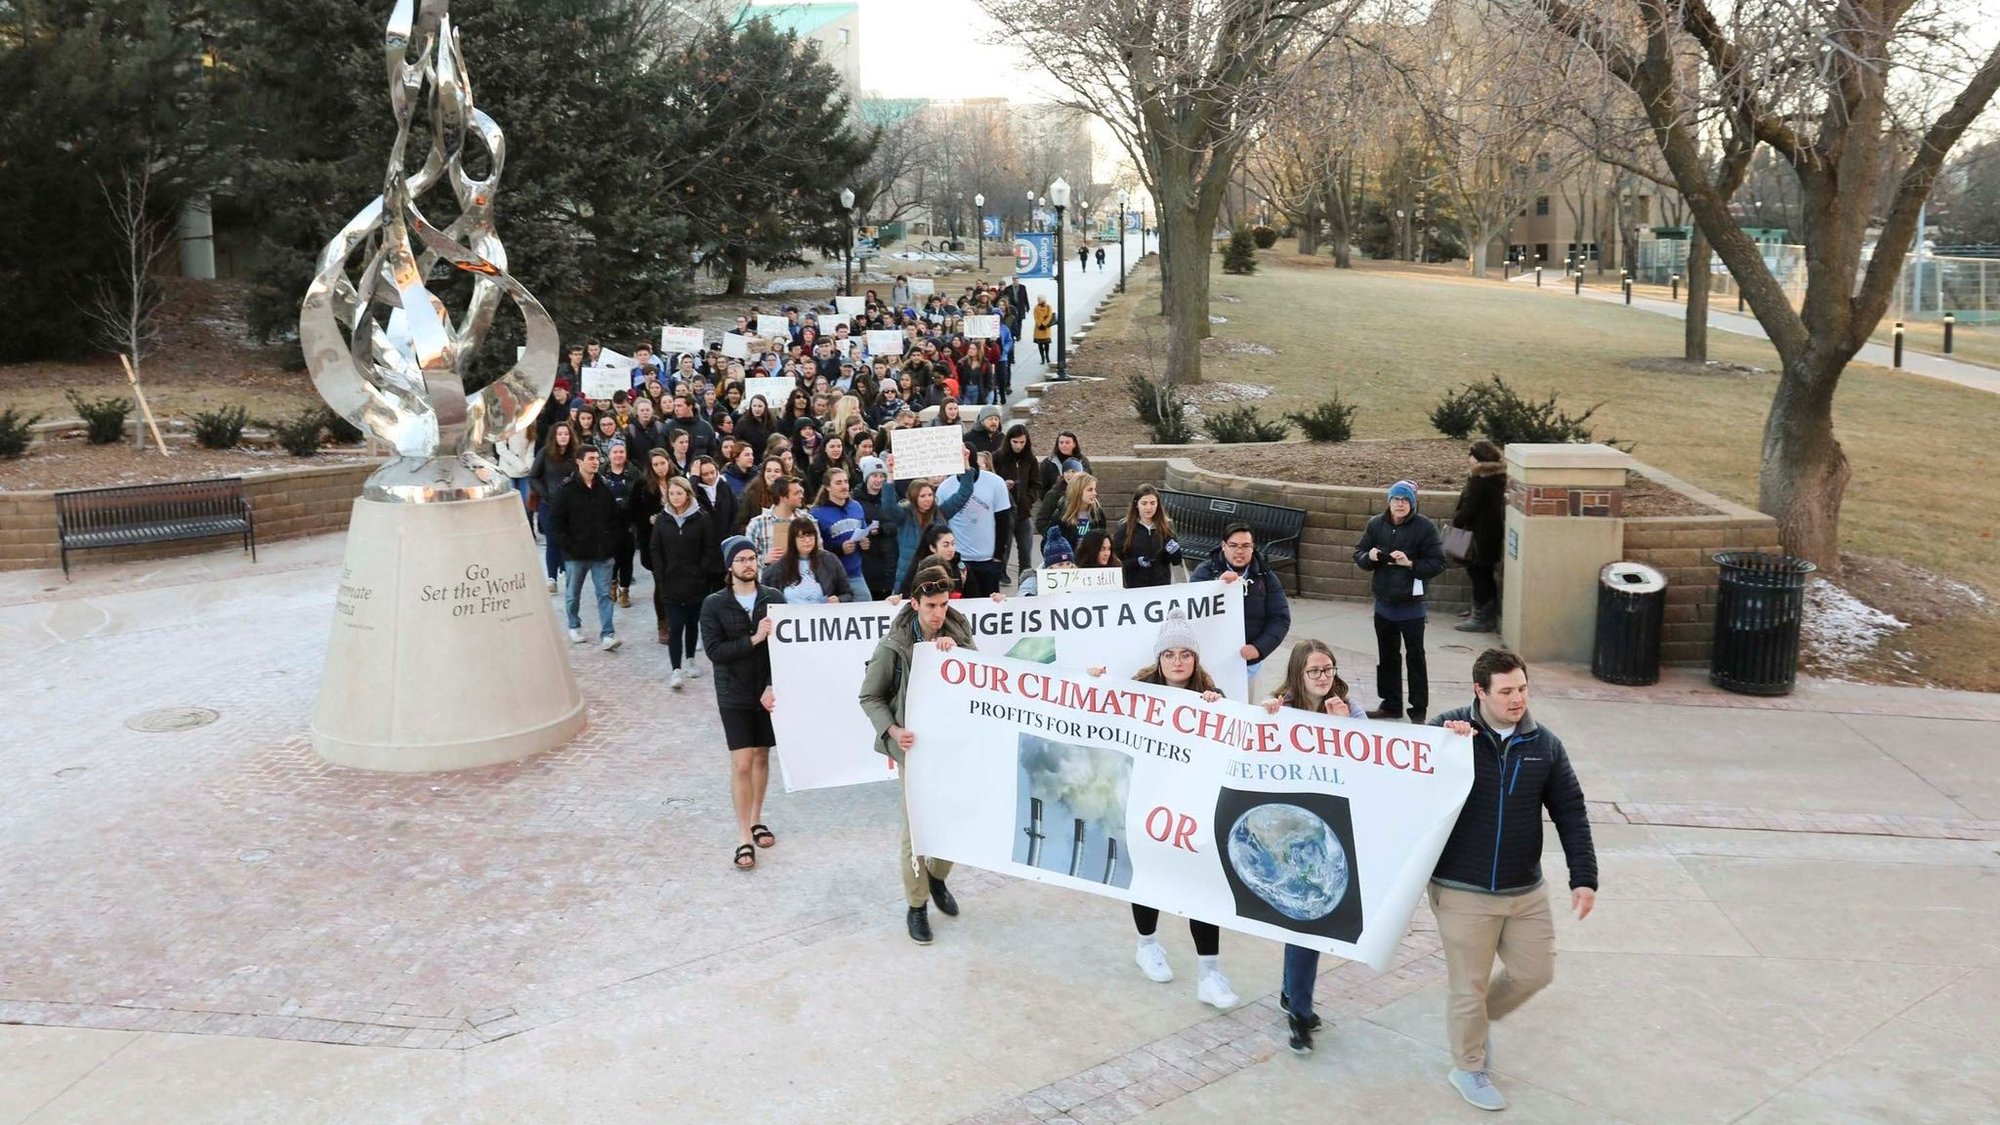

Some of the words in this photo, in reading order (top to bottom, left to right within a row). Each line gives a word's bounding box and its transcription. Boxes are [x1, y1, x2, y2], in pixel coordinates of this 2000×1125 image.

[420, 585, 448, 602] Set
[453, 582, 481, 600] the
[486, 572, 526, 595] World
[465, 563, 490, 581] Go
[1083, 573, 1092, 586] is
[1097, 571, 1116, 586] still
[452, 603, 474, 617] on
[480, 597, 511, 613] Fire
[776, 616, 890, 643] CLIMATE
[1020, 610, 1042, 633] IS
[1050, 605, 1109, 631] NOT
[1117, 603, 1136, 626] A
[940, 658, 1012, 694] OUR
[1017, 672, 1167, 727] CLIMATE
[1172, 705, 1282, 752] CHANGE
[1290, 723, 1435, 774] CHOICE
[969, 700, 1043, 729] PROFITS
[1046, 716, 1082, 738] FOR
[1087, 725, 1191, 764] POLLUTERS
[1258, 763, 1303, 781] FOR
[1308, 766, 1345, 785] ALL
[1145, 806, 1199, 853] OR
